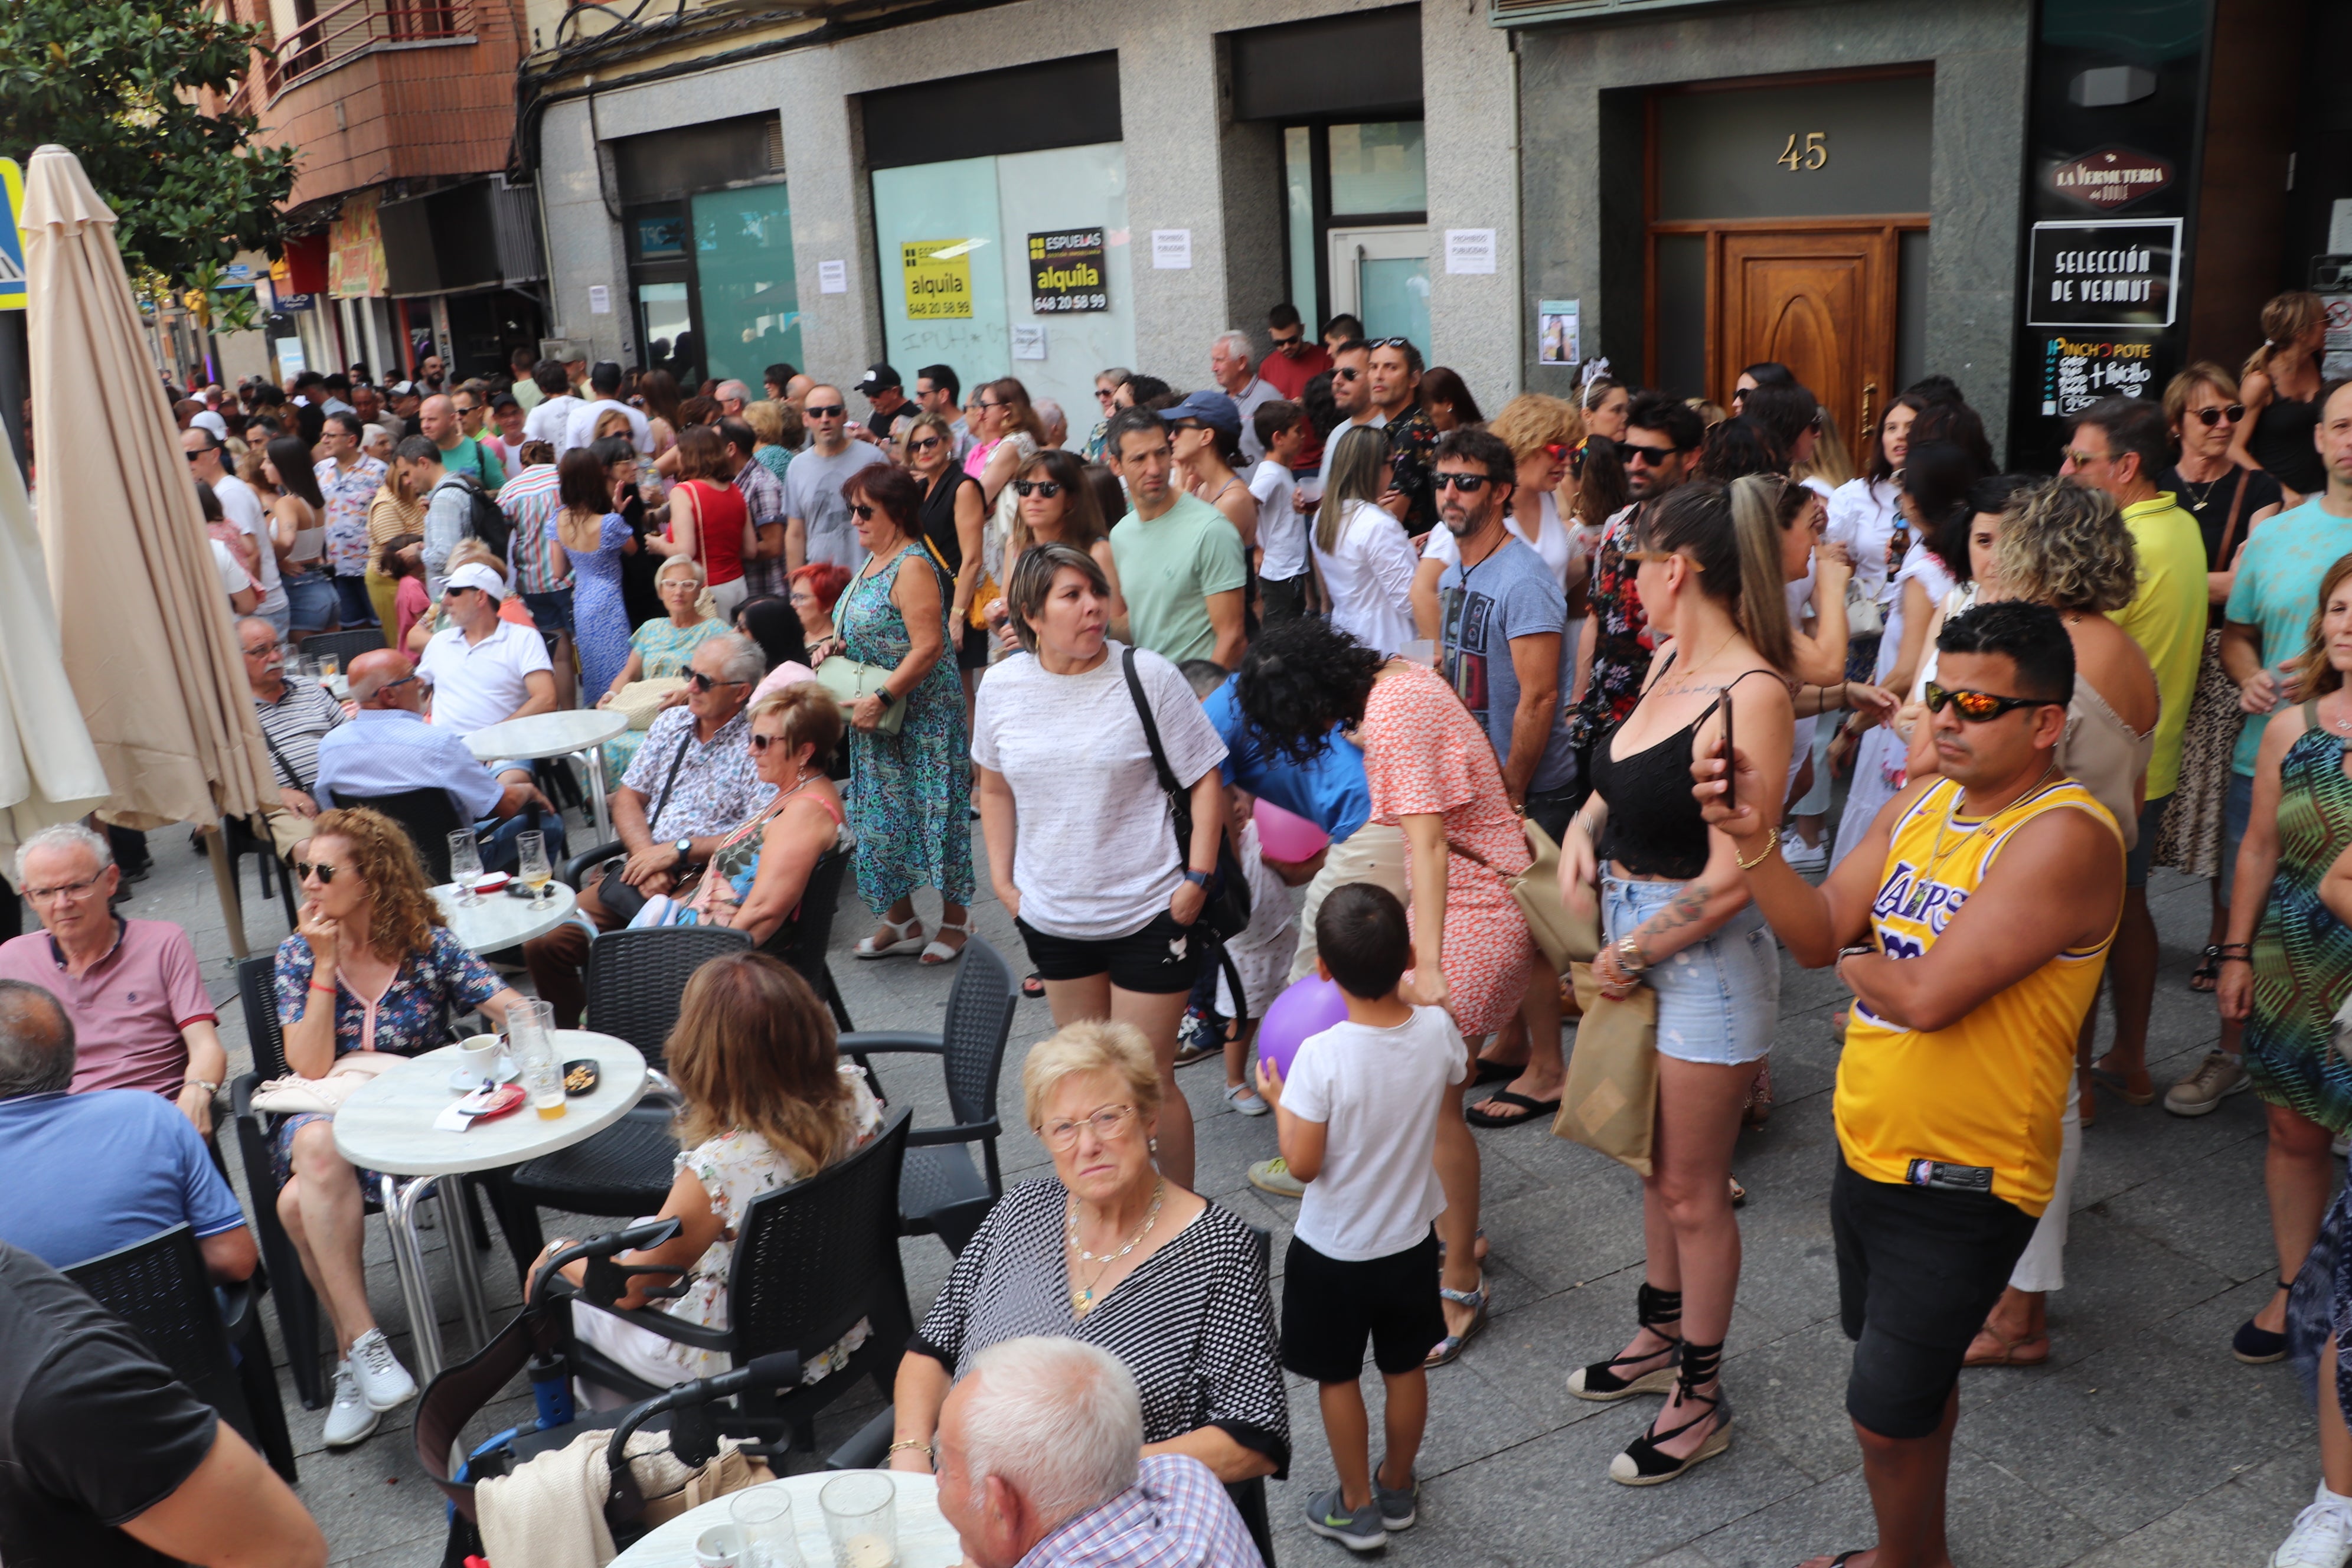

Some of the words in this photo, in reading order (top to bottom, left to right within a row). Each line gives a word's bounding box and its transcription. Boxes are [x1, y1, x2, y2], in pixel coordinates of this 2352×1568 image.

[1776, 132, 1828, 171] 45
[2056, 172, 2075, 187] LA
[1046, 232, 1102, 251] ESPUELAS
[2054, 243, 2151, 273] SELECCIÓN
[912, 272, 963, 299] alquila
[1037, 262, 1099, 293] alquila
[1034, 296, 1057, 311] 648
[1056, 295, 1073, 310] 20
[1073, 294, 1089, 309] 58
[1089, 293, 1106, 308] 99
[2050, 279, 2075, 302] DE
[2080, 279, 2153, 302] VERMUT
[929, 302, 941, 313] 20
[957, 300, 969, 313] 99
